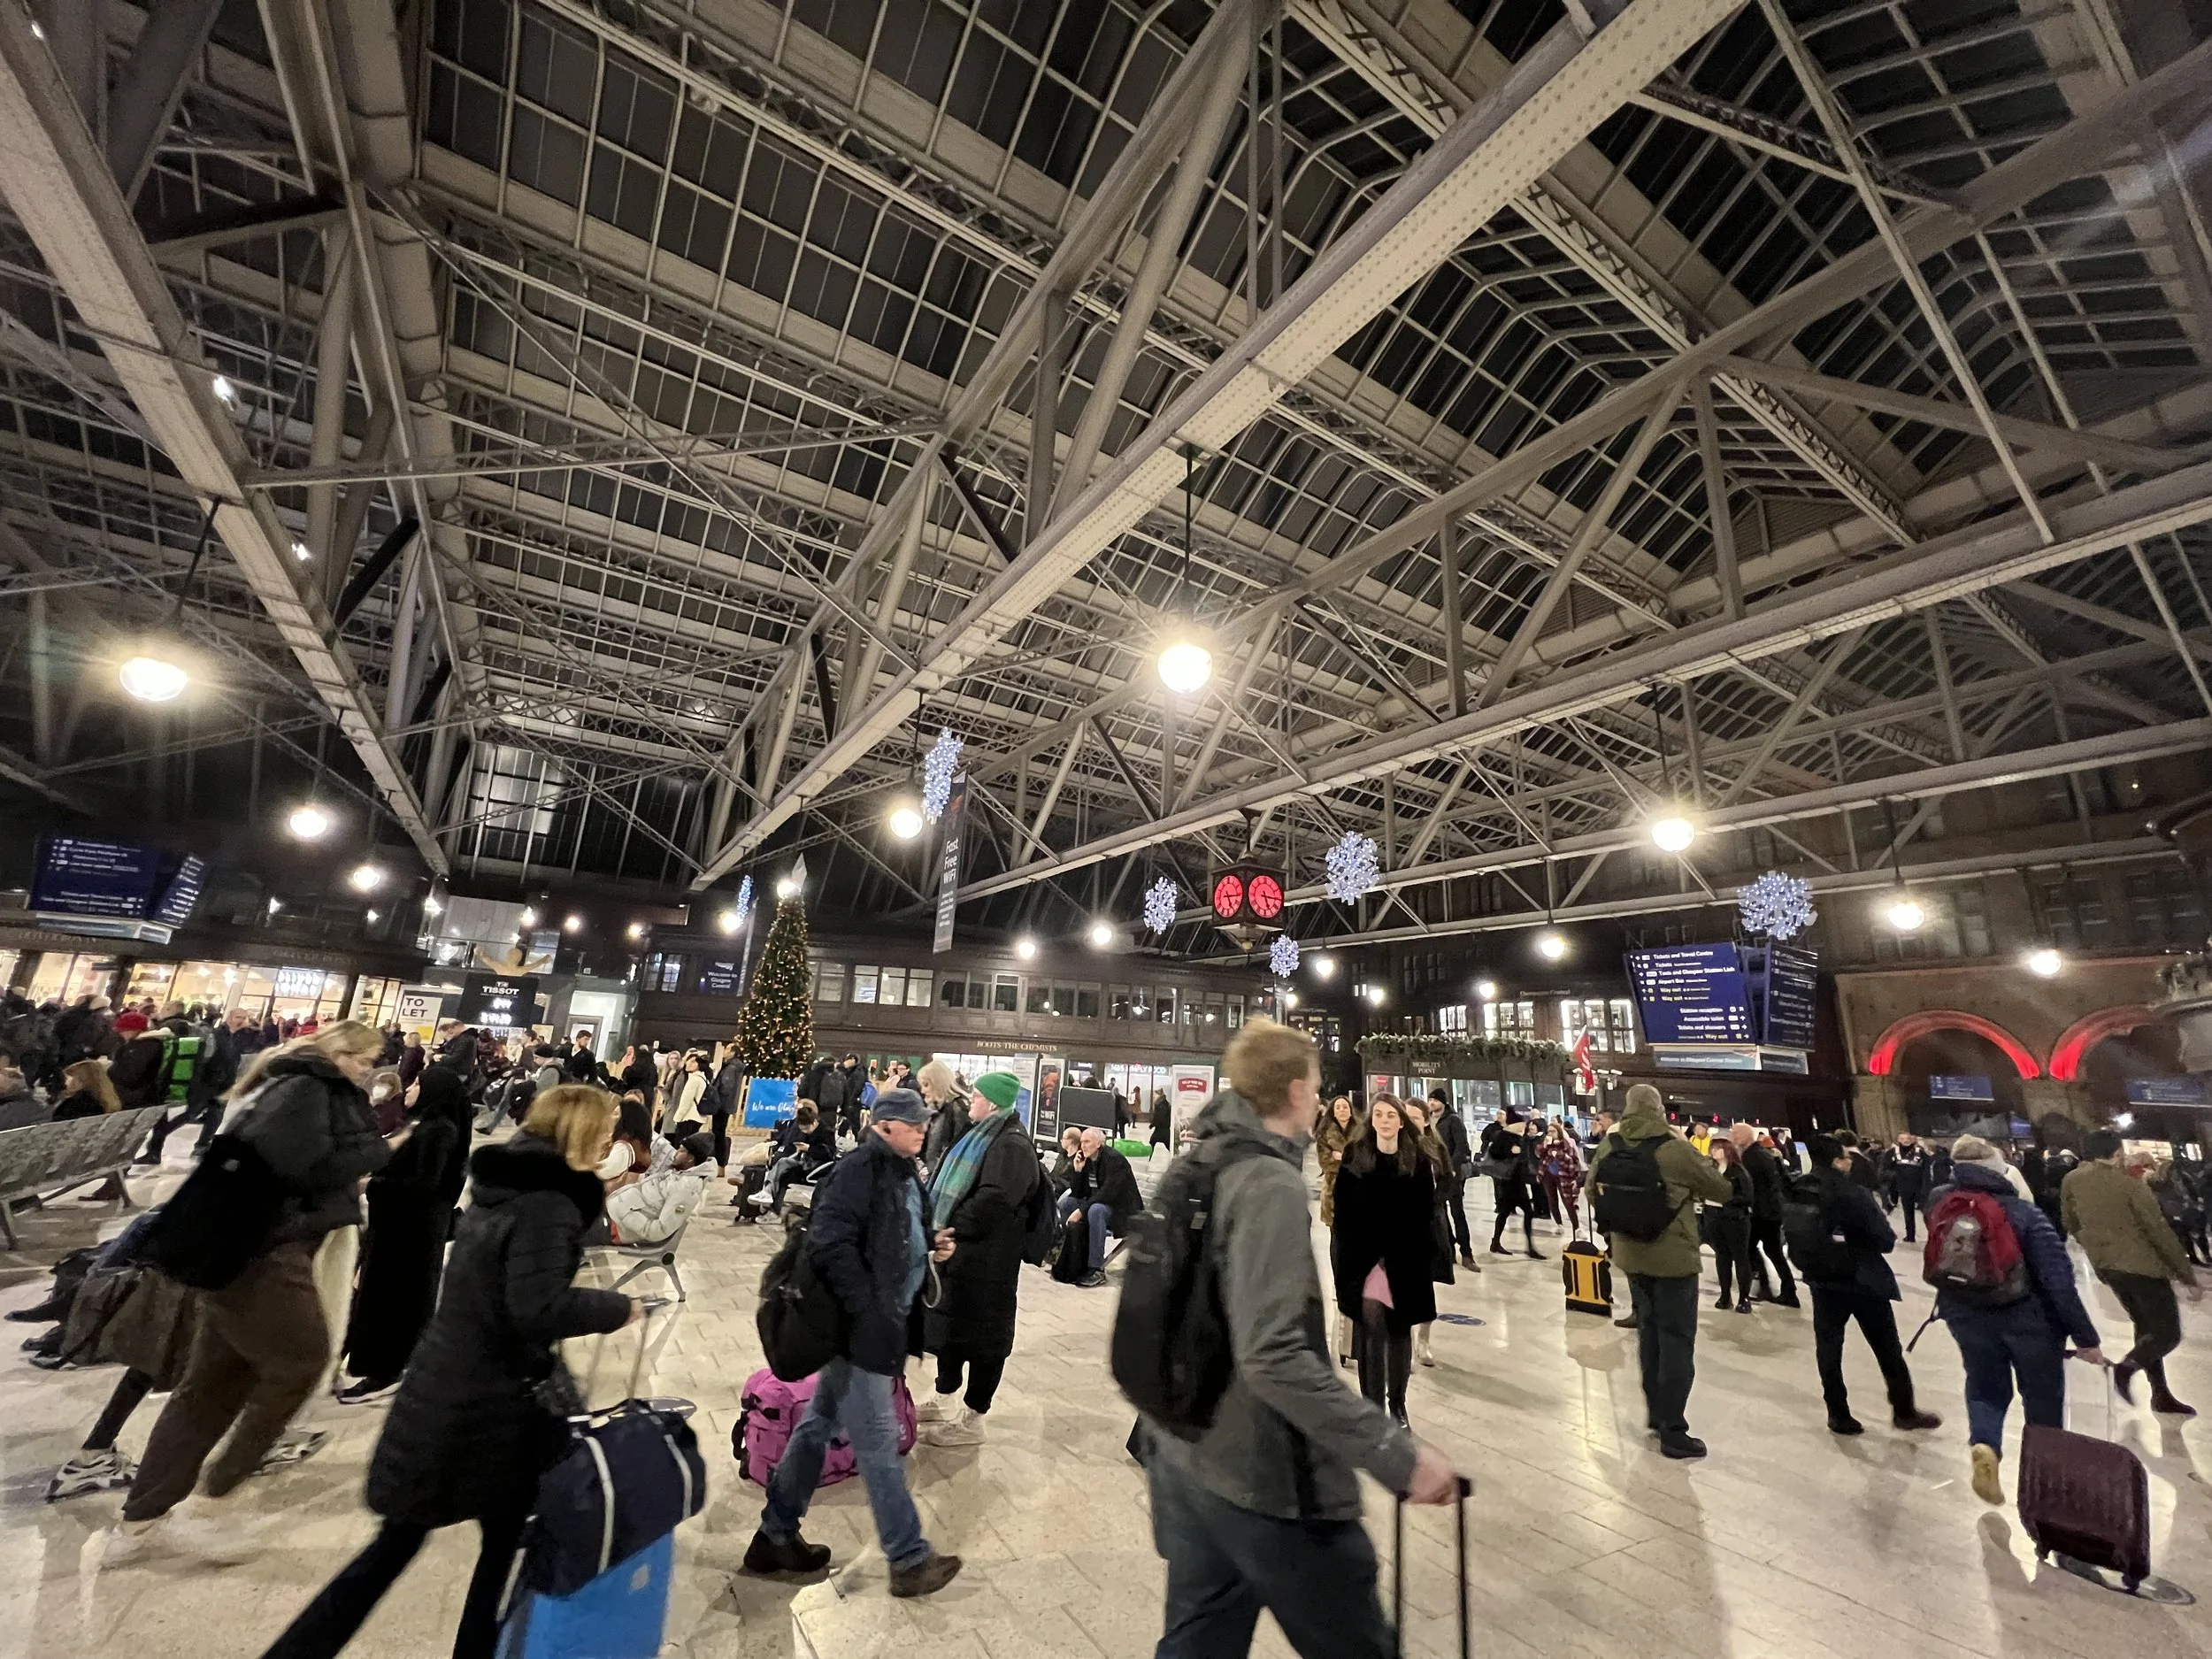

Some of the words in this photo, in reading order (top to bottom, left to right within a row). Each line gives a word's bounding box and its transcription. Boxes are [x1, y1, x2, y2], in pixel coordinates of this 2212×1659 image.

[946, 837, 958, 854] Fast
[944, 856, 957, 870] Free
[482, 986, 520, 995] TISSOT
[406, 997, 425, 1007] TO
[402, 1008, 428, 1018] LET
[1020, 1042, 1057, 1052] CHEMISTS
[752, 1100, 764, 1111] We
